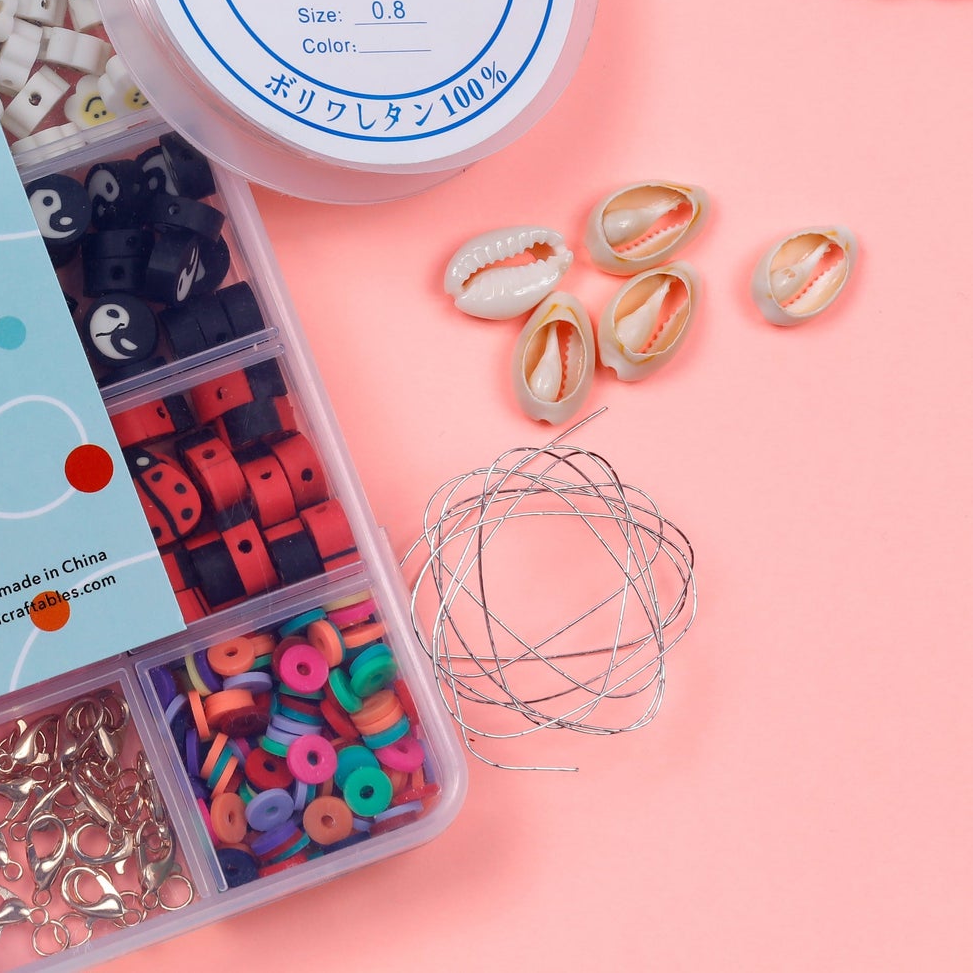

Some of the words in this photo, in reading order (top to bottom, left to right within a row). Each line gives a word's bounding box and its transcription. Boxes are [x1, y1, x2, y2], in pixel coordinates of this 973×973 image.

[297, 8, 343, 24] Size:
[371, 0, 406, 20] 0.8
[302, 38, 358, 55] Color:
[43, 567, 60, 581] in
[62, 551, 108, 574] China
